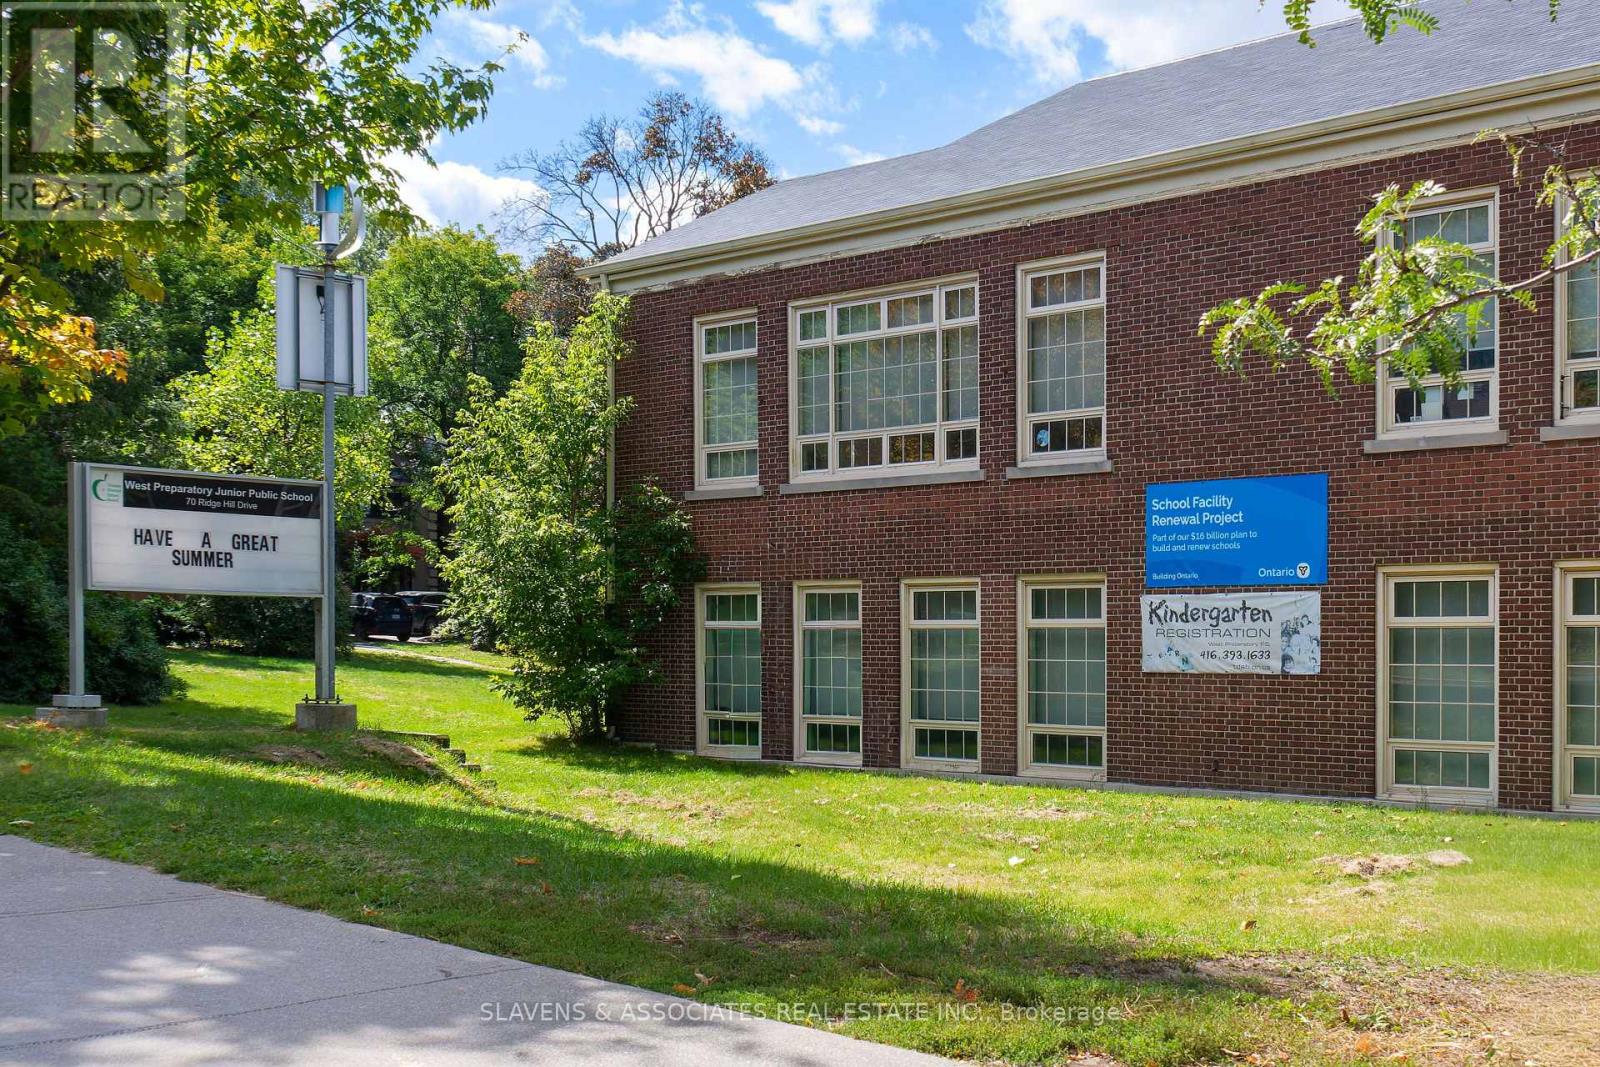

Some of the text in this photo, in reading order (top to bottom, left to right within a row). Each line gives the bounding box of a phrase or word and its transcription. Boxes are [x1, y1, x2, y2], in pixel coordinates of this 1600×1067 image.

[124, 480, 313, 502] West Preparatory Junior Public School
[186, 497, 258, 510] 70 Ridge Hill Drive
[1151, 495, 1233, 510] School Facility
[1152, 511, 1244, 526] Renewal Project
[134, 528, 278, 552] HAVE A GREAT
[1152, 534, 1167, 542] Part
[1168, 533, 1177, 541] of
[1191, 532, 1205, 540] $16
[1206, 531, 1229, 540] billion
[1230, 531, 1248, 540] plan
[1249, 530, 1258, 538] to
[1152, 541, 1241, 552] build and renew schools
[172, 550, 233, 568] SUMMER
[1152, 571, 1199, 581] Building Ontario
[1258, 567, 1296, 577] Ontario
[1149, 600, 1273, 628] Kindergarten
[1155, 628, 1271, 638] REGISTRATION
[1200, 650, 1271, 661] 416.393.1633
